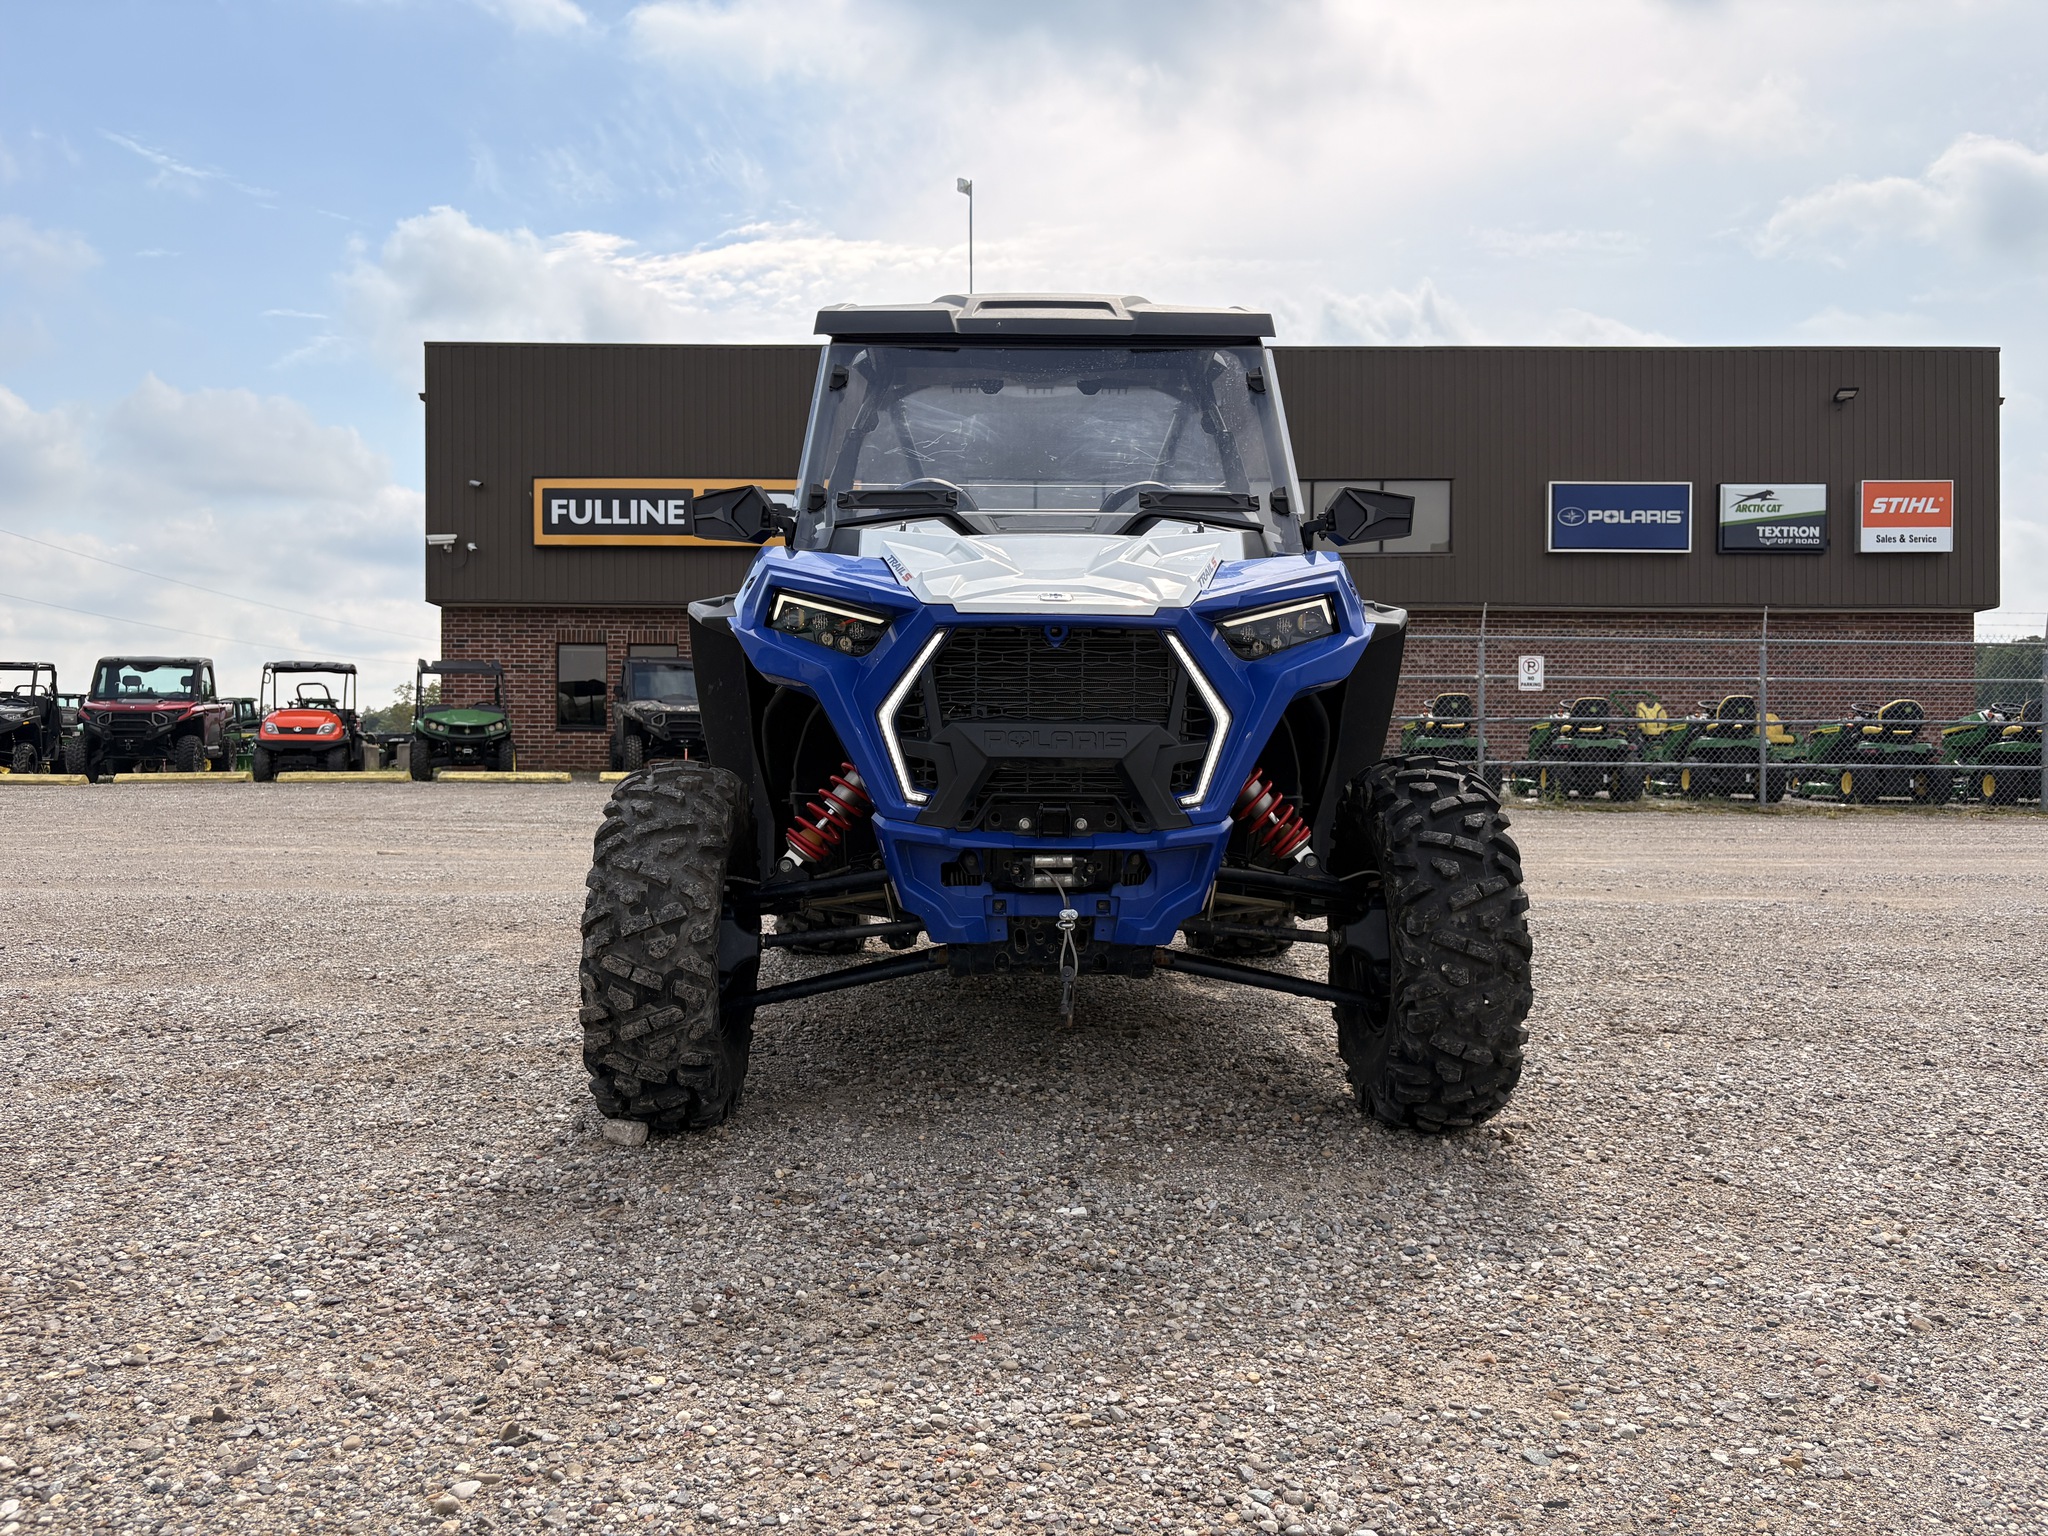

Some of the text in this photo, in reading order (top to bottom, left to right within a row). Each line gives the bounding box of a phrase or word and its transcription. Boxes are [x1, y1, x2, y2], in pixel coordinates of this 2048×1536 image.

[551, 499, 685, 524] FULLINE
[1735, 504, 1782, 512] ARCTIC CAT
[1870, 497, 1940, 513] STIHL
[1587, 510, 1682, 523] POLARIS
[1756, 526, 1820, 537] TEXTRON
[1876, 534, 1937, 543] Sales & Service
[983, 730, 1128, 749] POLARIS
